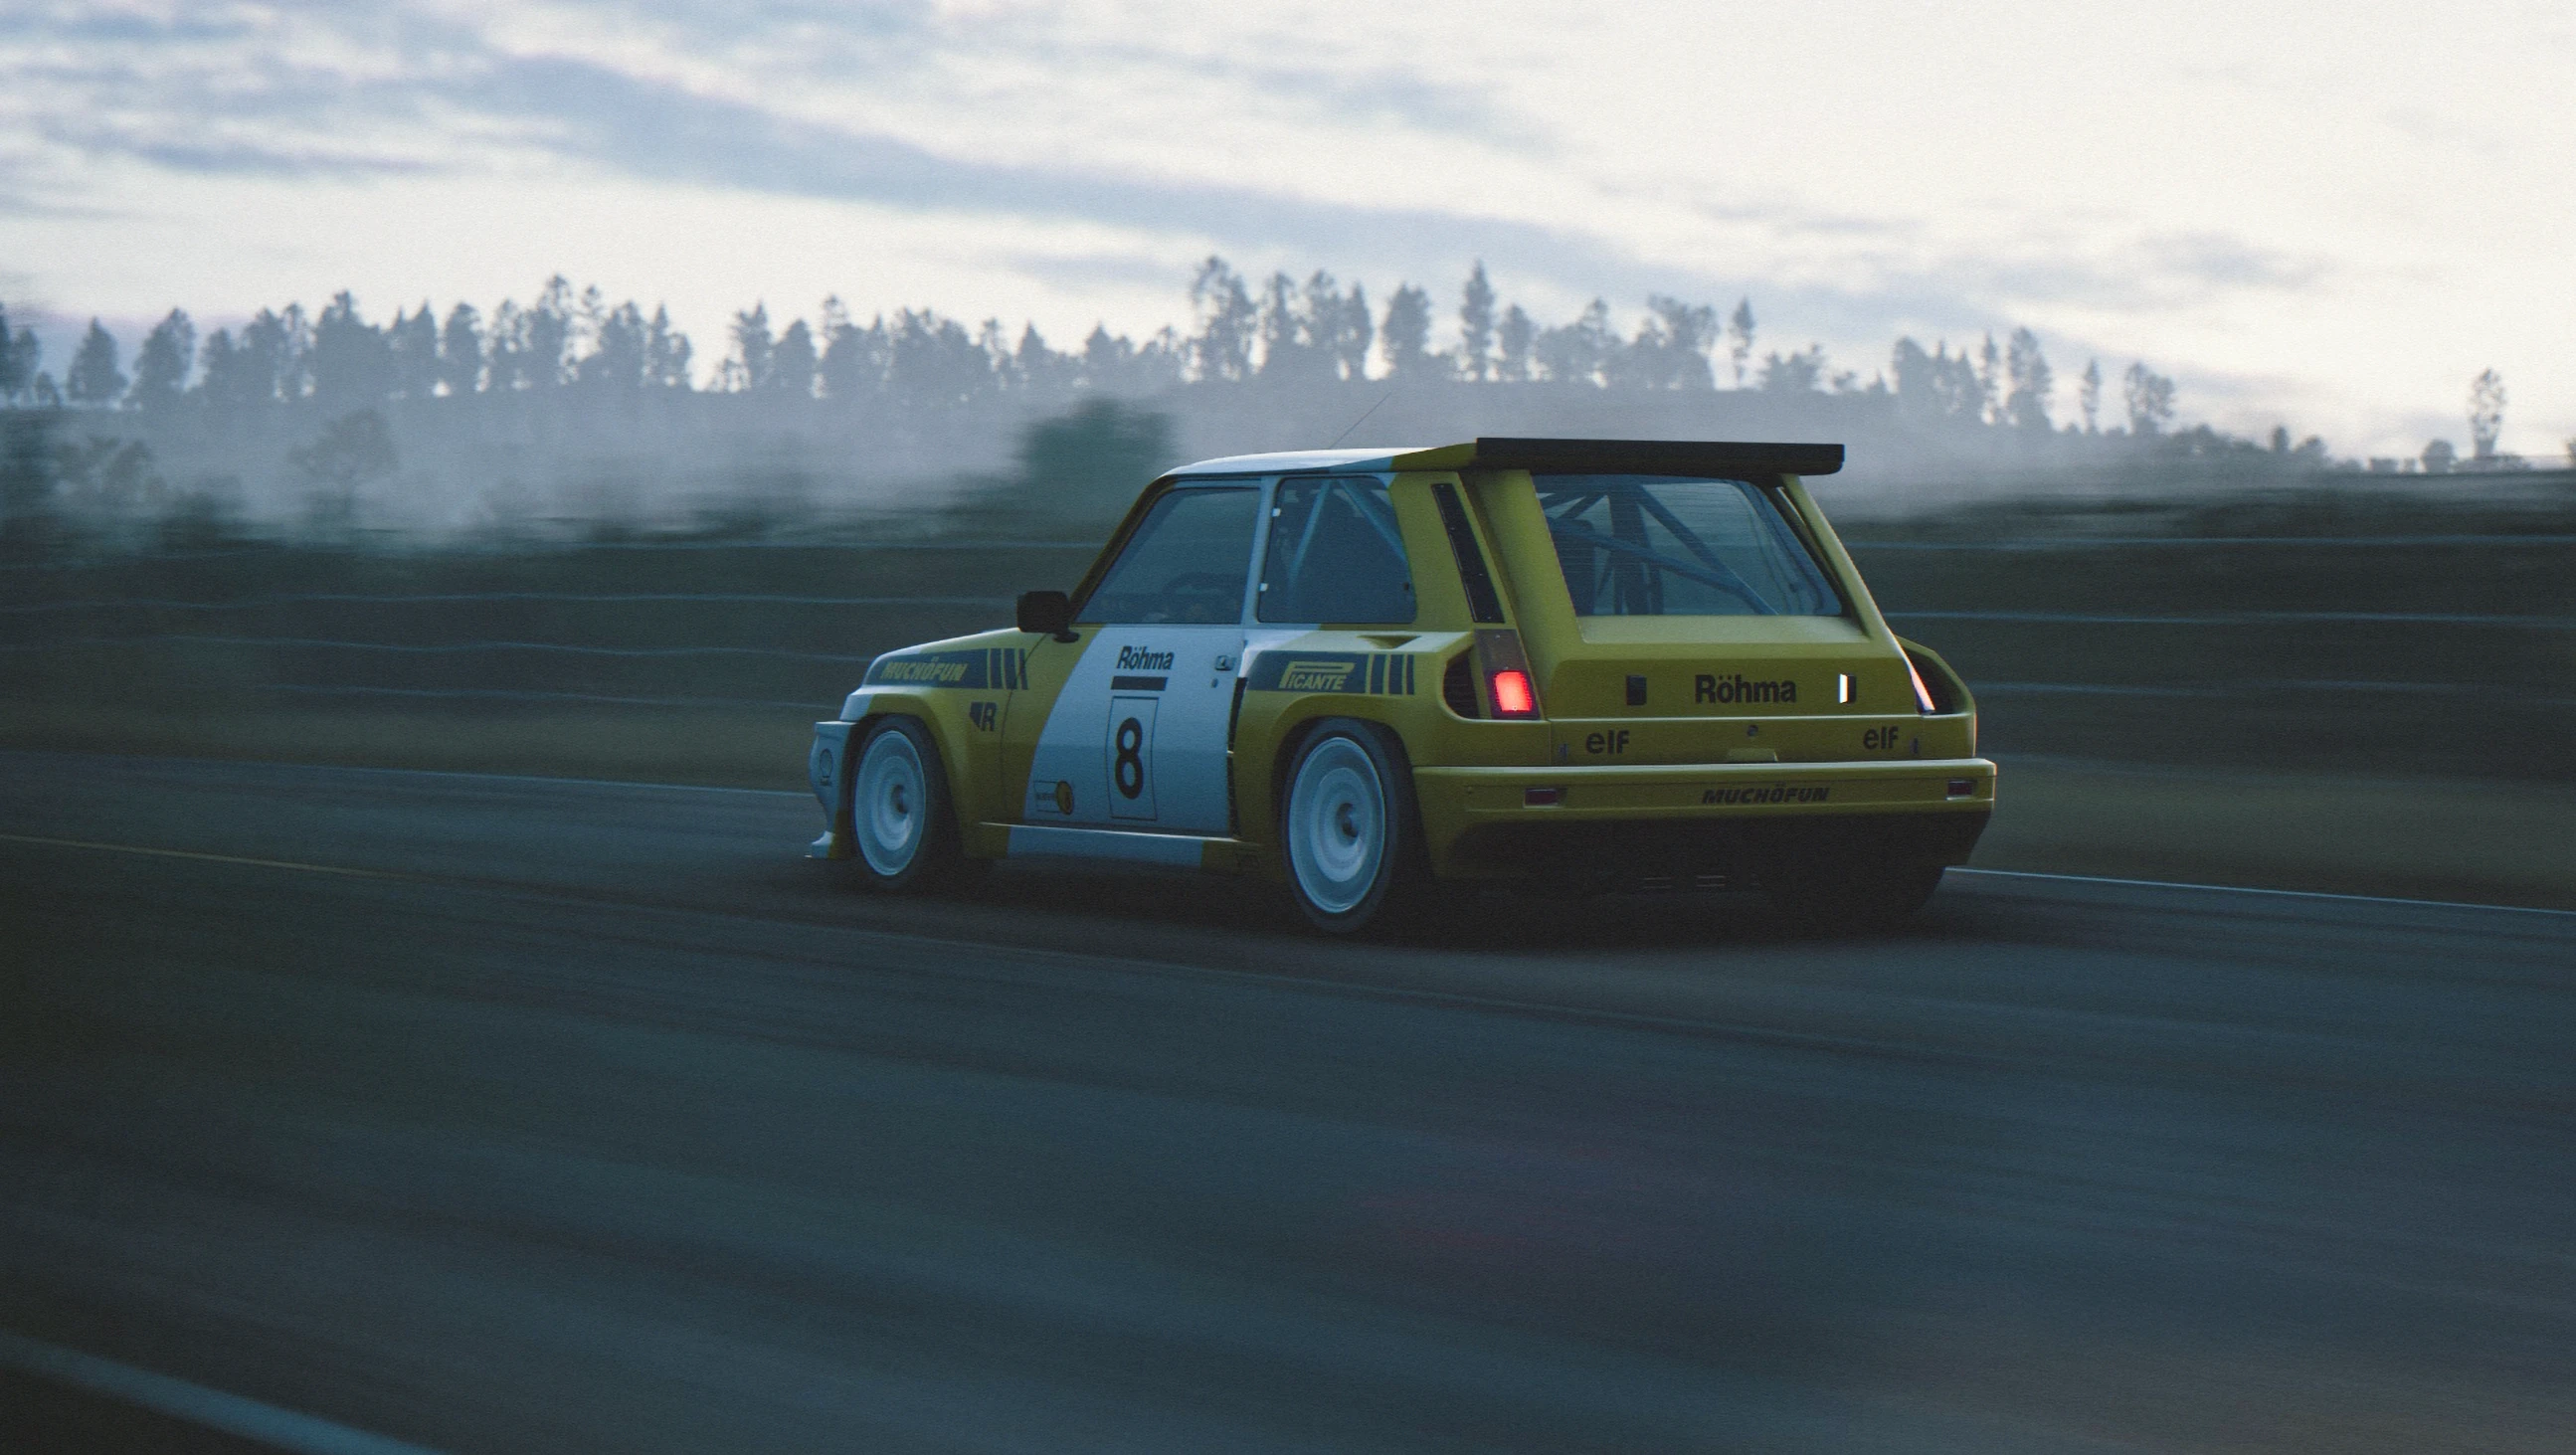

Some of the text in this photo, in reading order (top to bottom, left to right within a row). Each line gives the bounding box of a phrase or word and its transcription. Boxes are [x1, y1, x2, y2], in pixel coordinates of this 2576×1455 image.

[880, 656, 968, 682] MUCHÖFUN
[1116, 645, 1175, 670] Röhma
[1278, 660, 1356, 690] PICANTE
[1695, 674, 1796, 703] Röhma
[1585, 729, 1629, 754] elf
[1863, 726, 1899, 750] elf
[1115, 717, 1143, 800] 8
[1702, 781, 1830, 805] MUCHÖFUN
